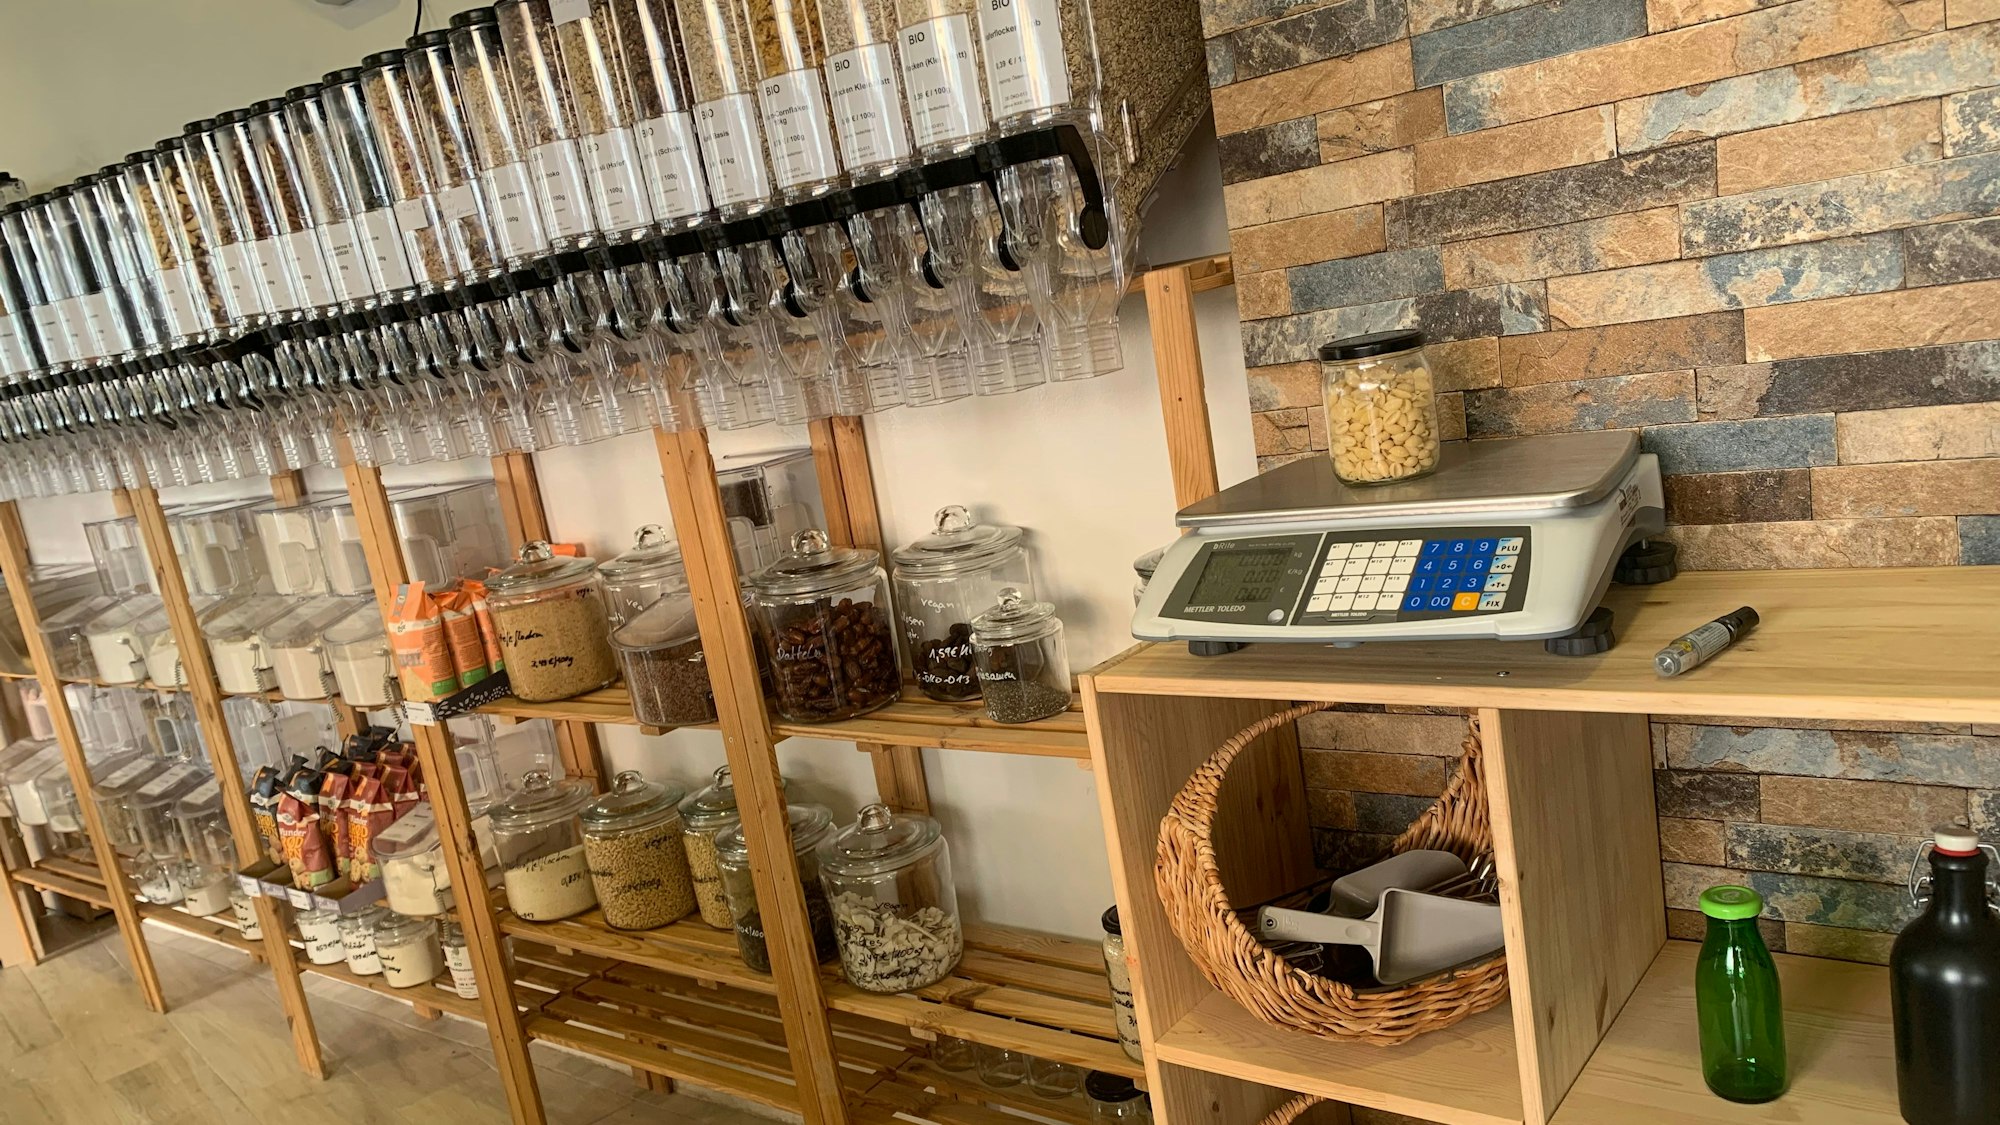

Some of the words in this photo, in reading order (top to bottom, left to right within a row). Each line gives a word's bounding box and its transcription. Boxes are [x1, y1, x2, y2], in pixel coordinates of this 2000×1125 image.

[908, 31, 925, 45] BIO
[834, 59, 850, 72] BIO
[765, 84, 780, 97] BIO
[1431, 543, 1440, 553] 7
[1454, 542, 1464, 553] 8
[1479, 541, 1489, 552] 9
[1423, 561, 1433, 571] 4
[1448, 560, 1457, 570] 5
[1473, 559, 1483, 570] 6
[1419, 581, 1425, 589] 1
[1441, 578, 1452, 589] 2
[1467, 577, 1477, 588] 3
[920, 598, 955, 614] vegan
[1410, 596, 1421, 607] 0
[1430, 596, 1451, 607] 00
[1460, 596, 1470, 606] C
[1184, 605, 1215, 614] METTLER
[1216, 604, 1246, 613] TOLEDO
